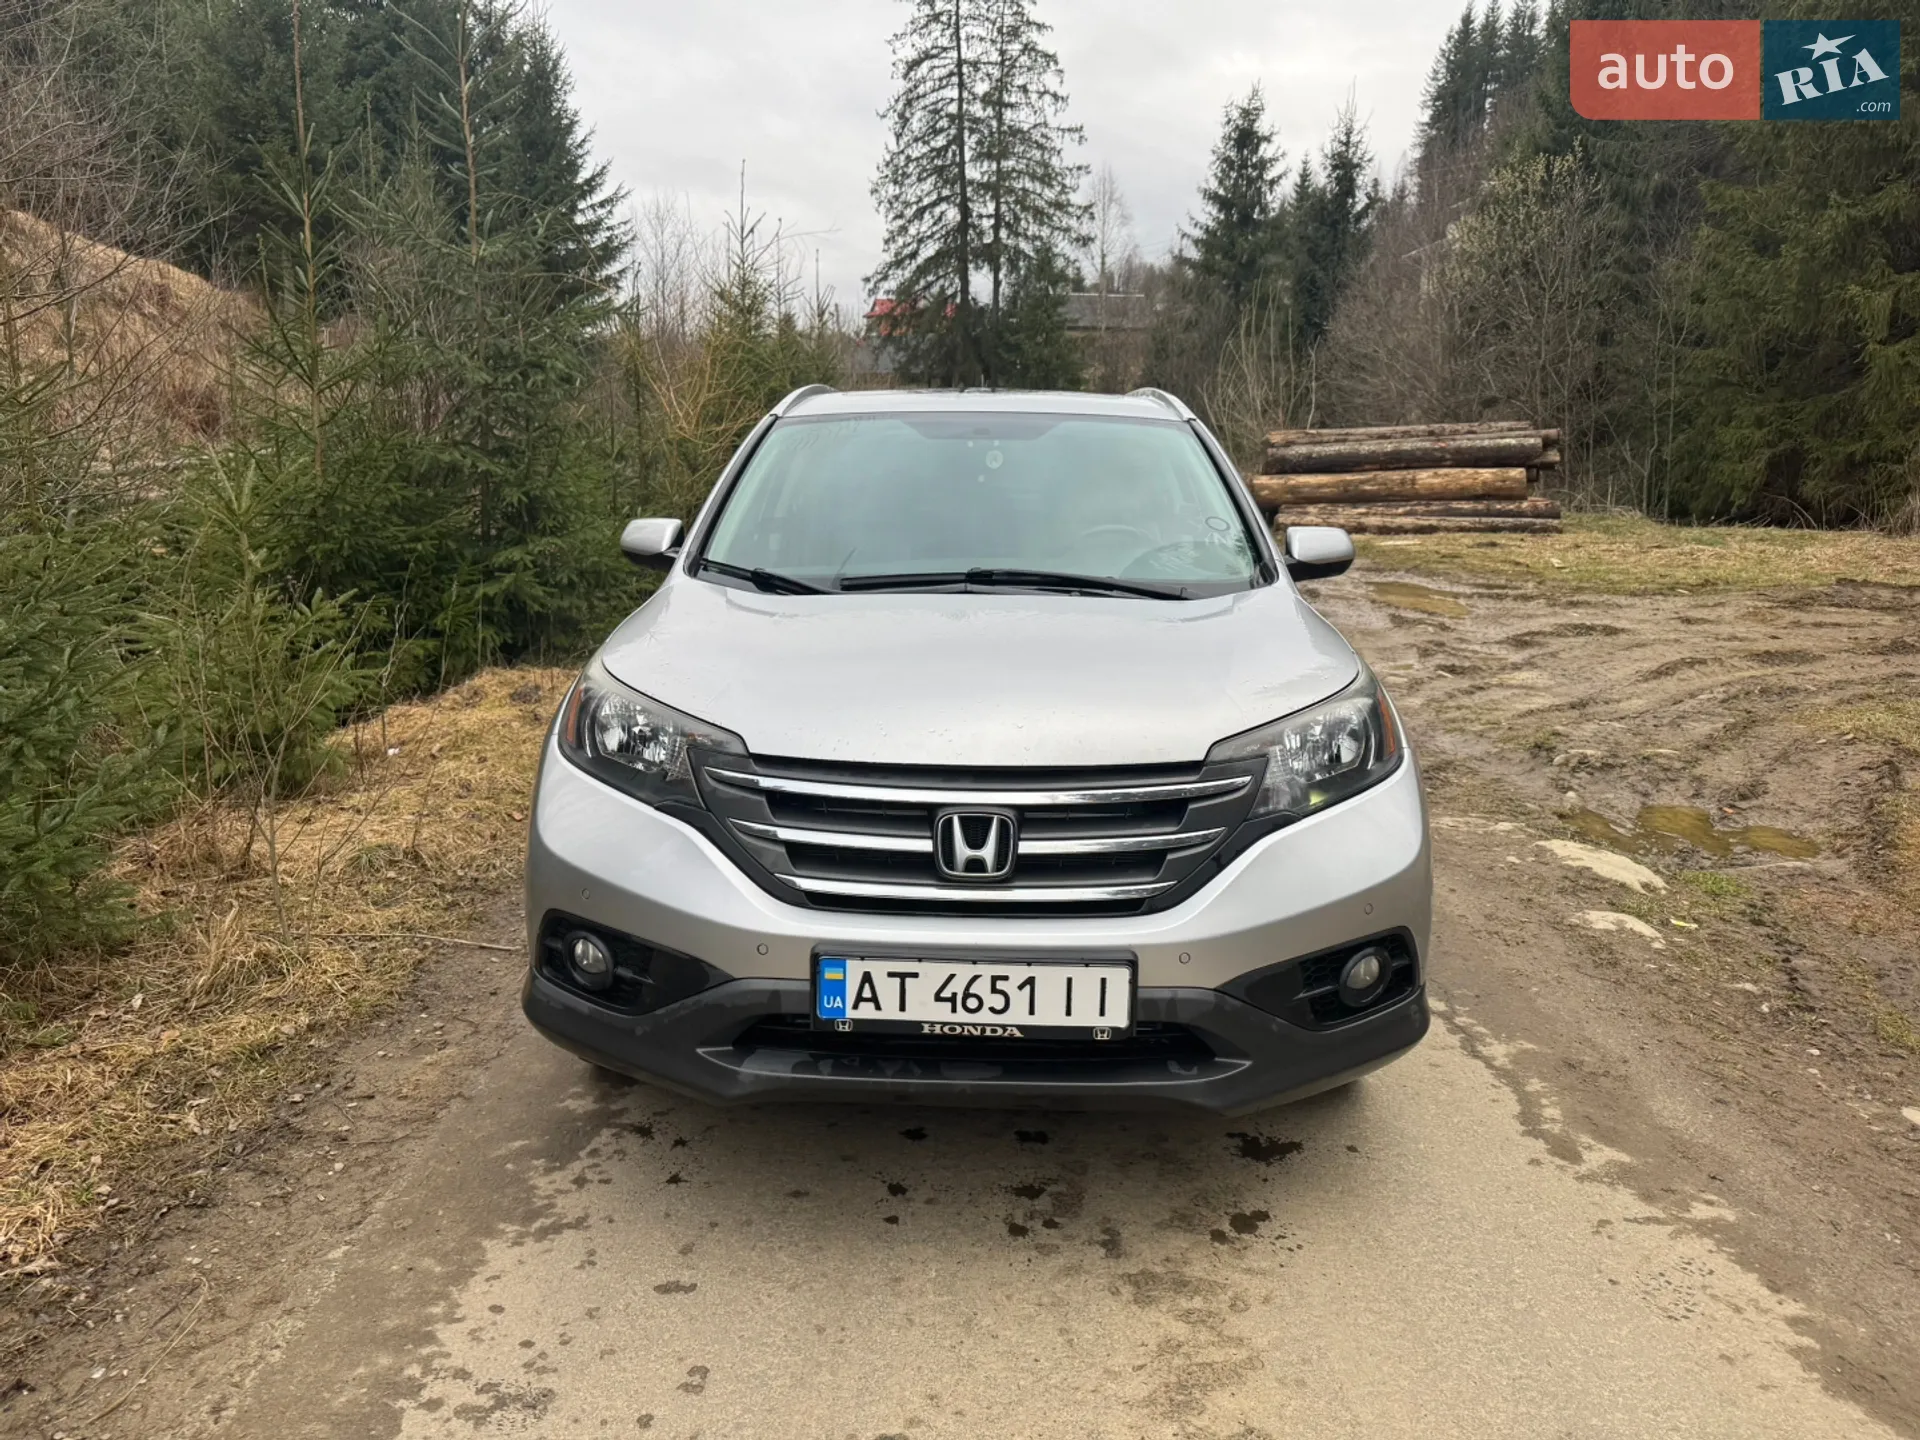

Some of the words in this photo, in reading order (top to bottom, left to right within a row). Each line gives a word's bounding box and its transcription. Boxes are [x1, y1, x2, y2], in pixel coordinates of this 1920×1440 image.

[851, 970, 920, 1012] AT
[933, 973, 1035, 1016] 4651
[1065, 976, 1107, 1017] II
[824, 995, 843, 1008] UA
[921, 1023, 1024, 1038] HONDA
